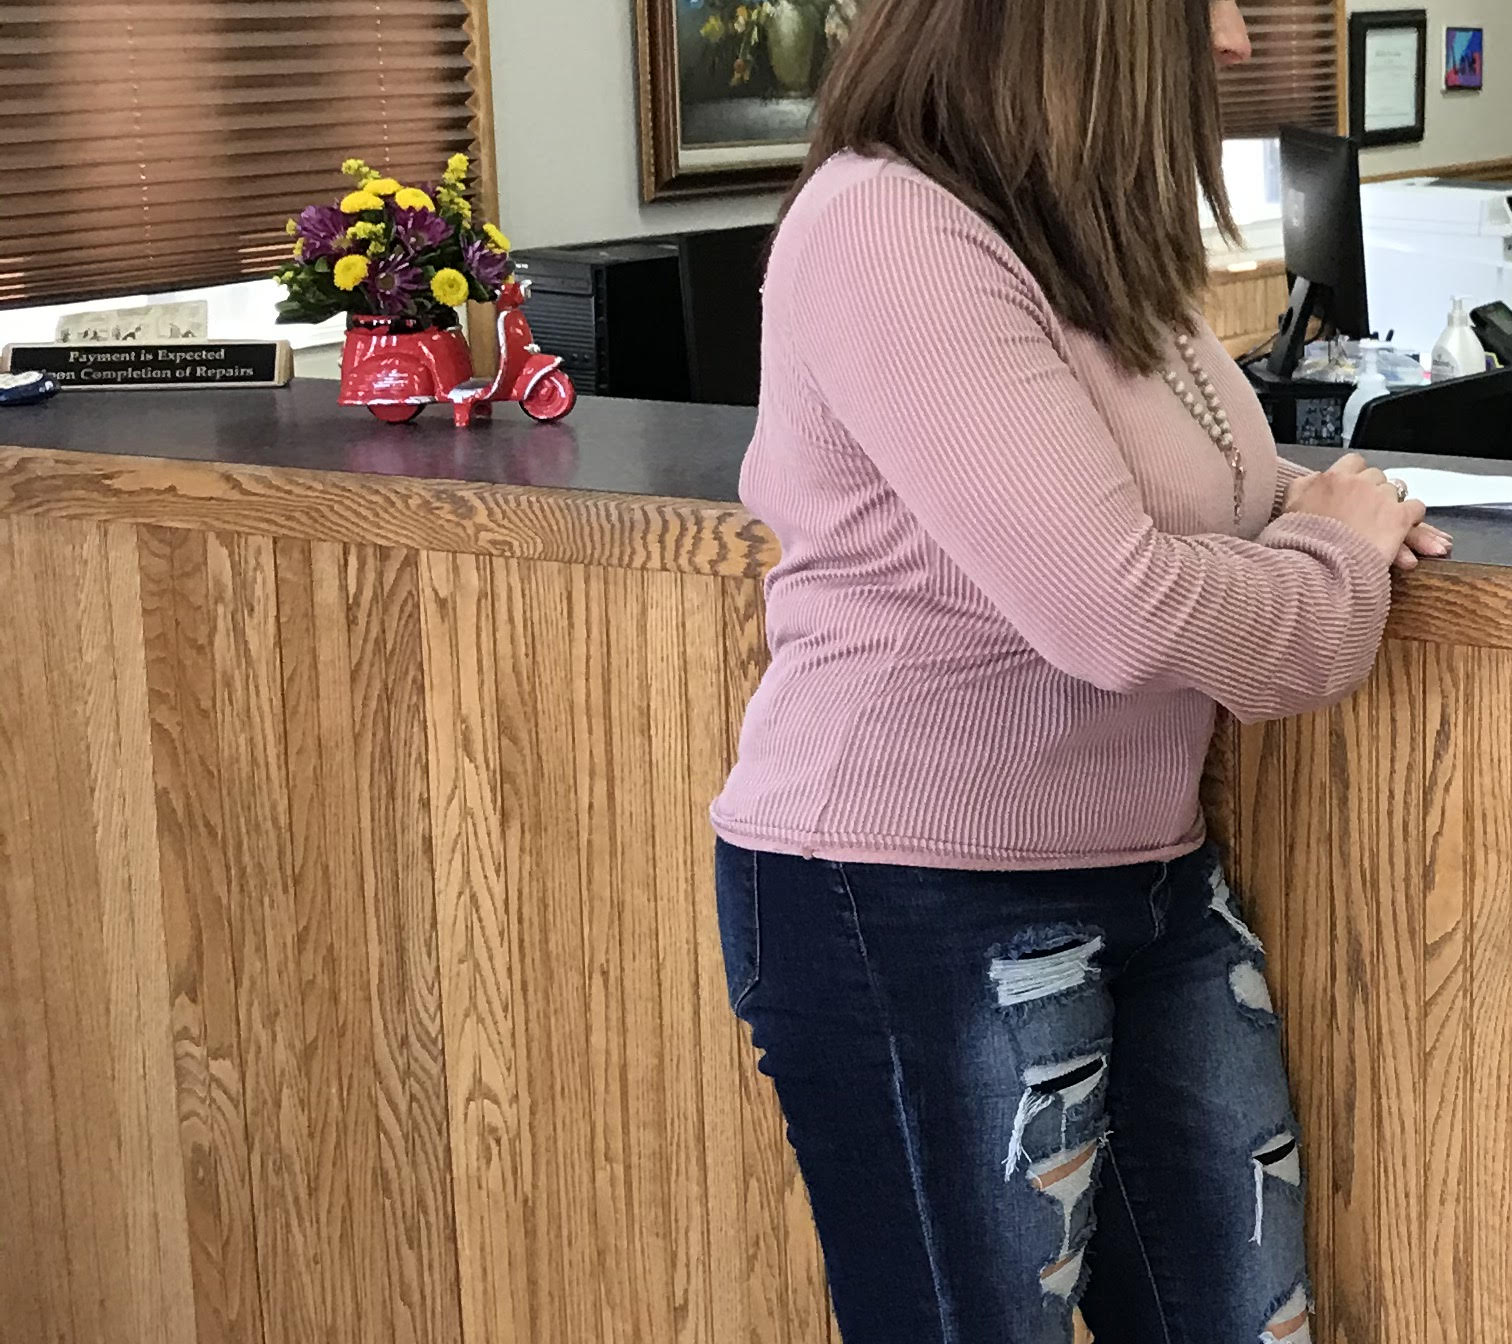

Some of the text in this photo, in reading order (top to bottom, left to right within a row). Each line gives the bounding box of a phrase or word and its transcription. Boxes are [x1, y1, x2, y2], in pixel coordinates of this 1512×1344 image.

[68, 348, 225, 366] Payment is Expected
[80, 367, 172, 382] Completion
[175, 366, 193, 378] of
[195, 365, 254, 380] Repairs
